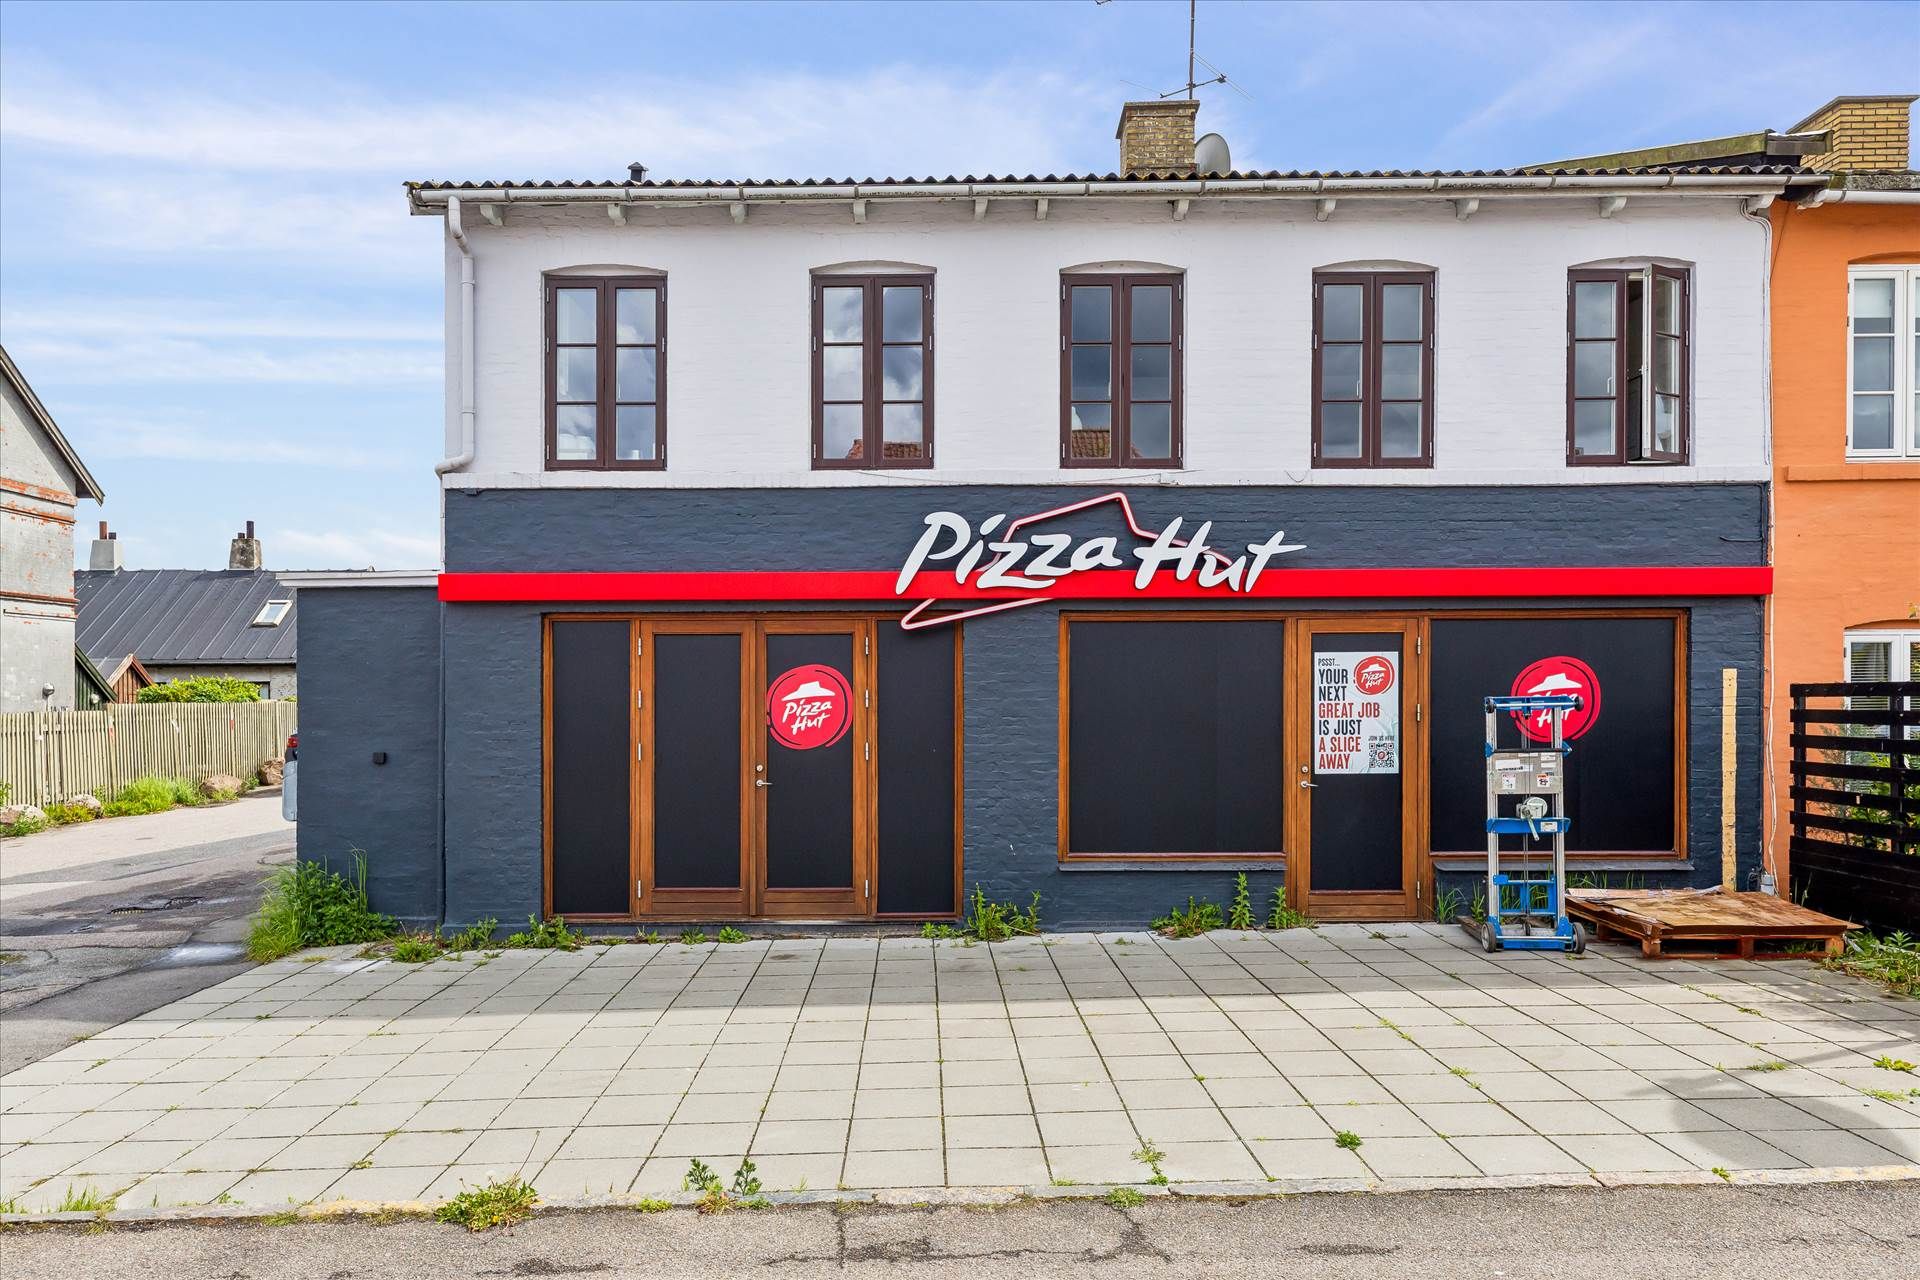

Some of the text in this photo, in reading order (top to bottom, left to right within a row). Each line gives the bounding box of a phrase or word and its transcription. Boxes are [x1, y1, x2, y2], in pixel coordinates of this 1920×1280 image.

[896, 511, 1308, 595] Pizza Hut
[1318, 668, 1349, 685] YOUR
[1361, 672, 1385, 683] Pizza
[1365, 678, 1384, 689] Hut
[1318, 685, 1347, 702] NEXT
[782, 699, 832, 725] Pizza
[1318, 702, 1381, 719] GREAT JOB
[791, 713, 831, 735] Hut
[1318, 719, 1362, 736] IS JUST
[1318, 736, 1362, 753] A SLICE
[1318, 753, 1351, 770] AWAY
